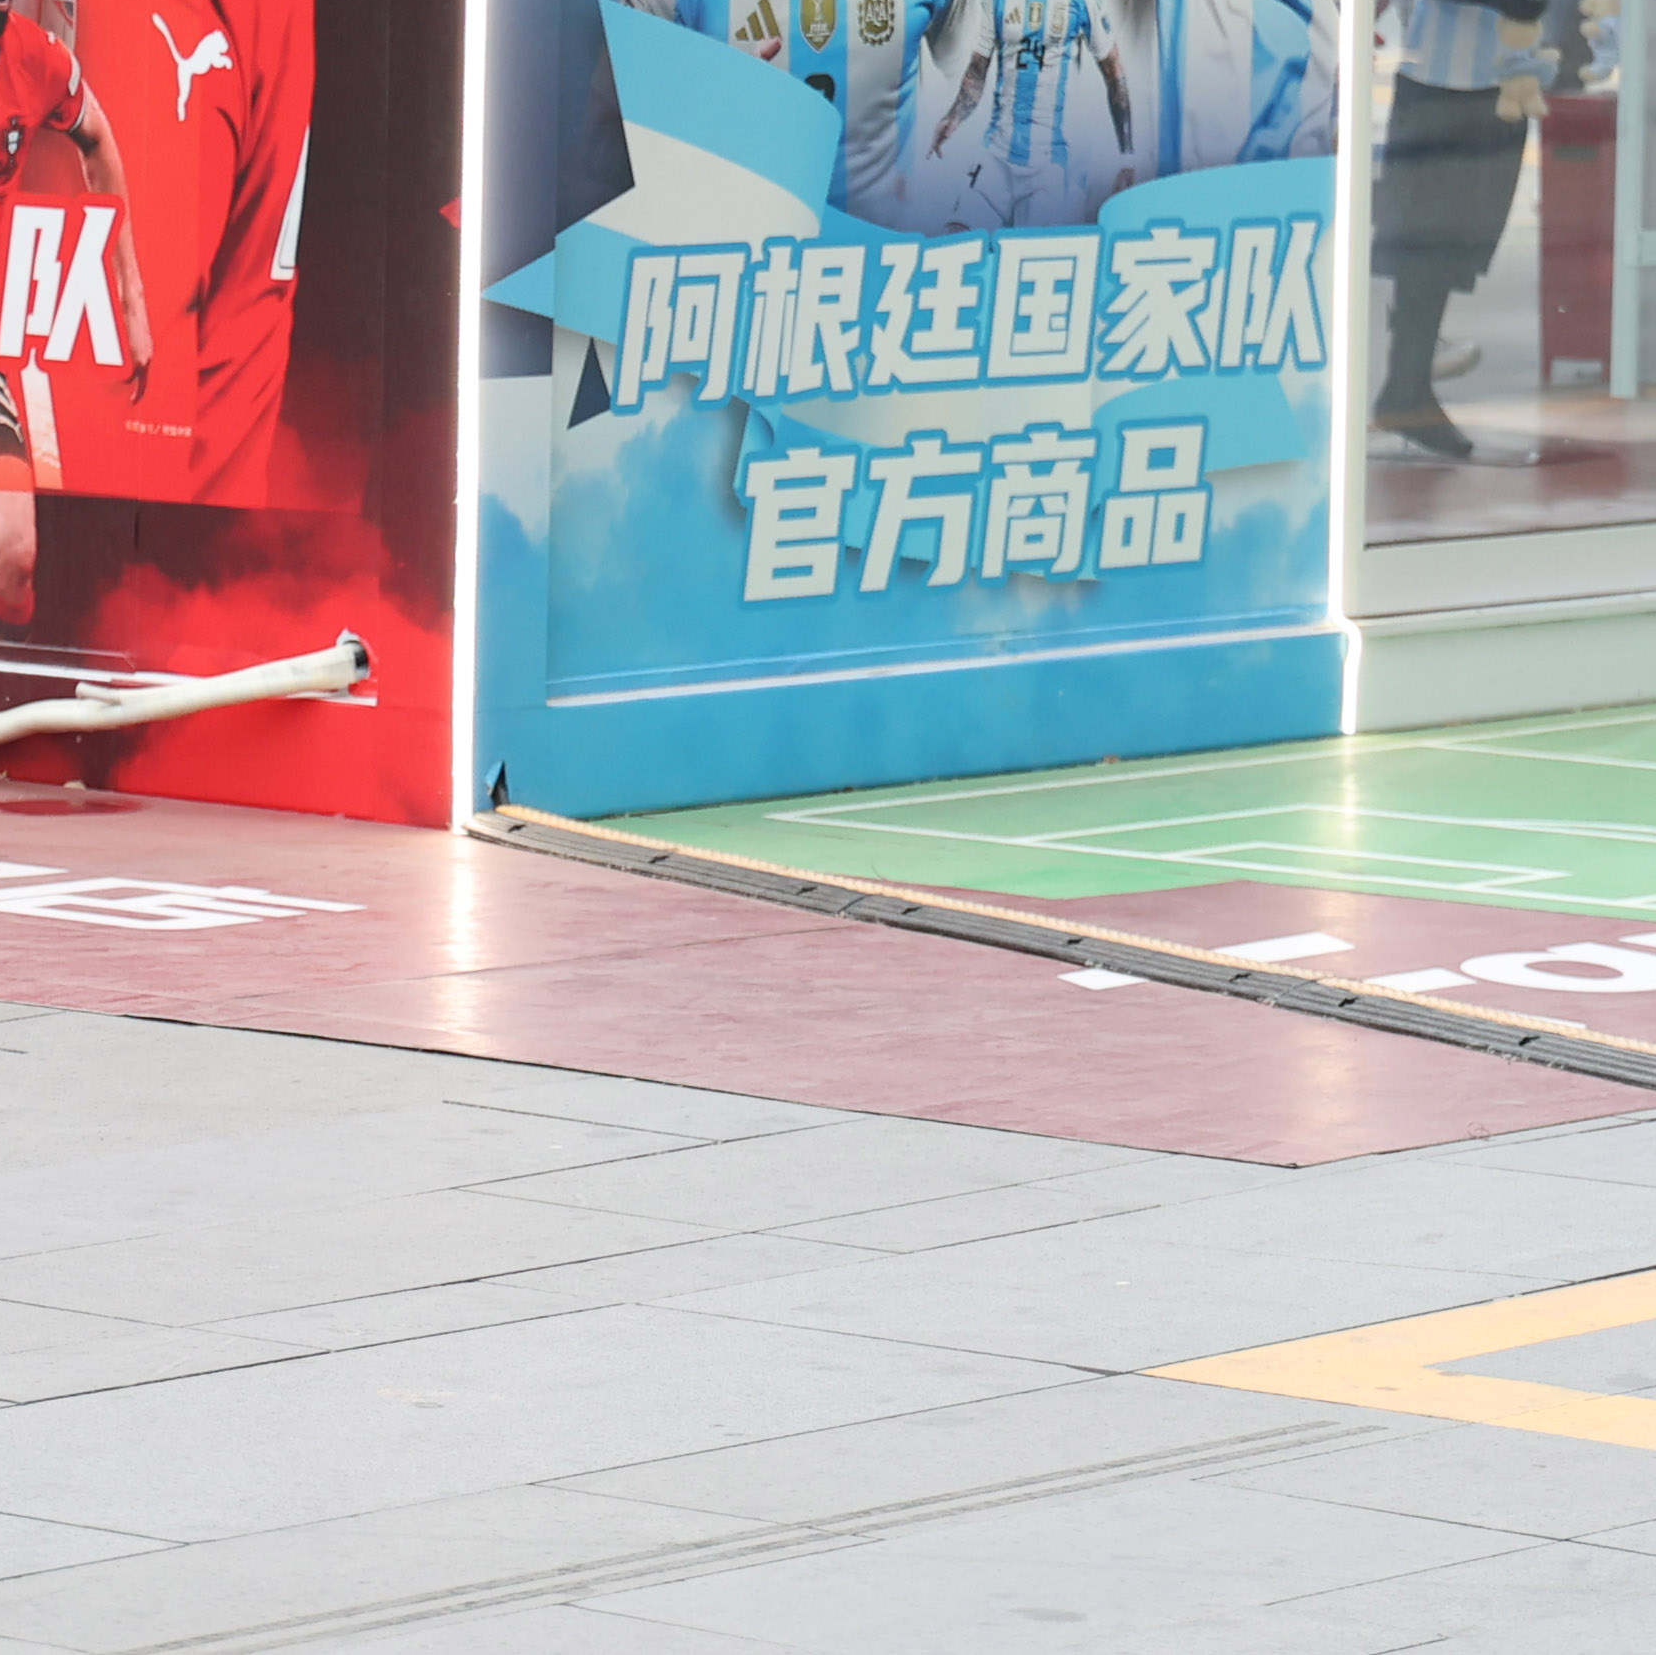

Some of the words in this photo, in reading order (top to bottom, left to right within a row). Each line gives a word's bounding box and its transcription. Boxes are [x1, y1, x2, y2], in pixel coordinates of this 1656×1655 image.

[1015, 36, 1046, 73] 24
[615, 221, 1330, 407] 阿根廷国家队
[744, 424, 1208, 603] 官方商品
